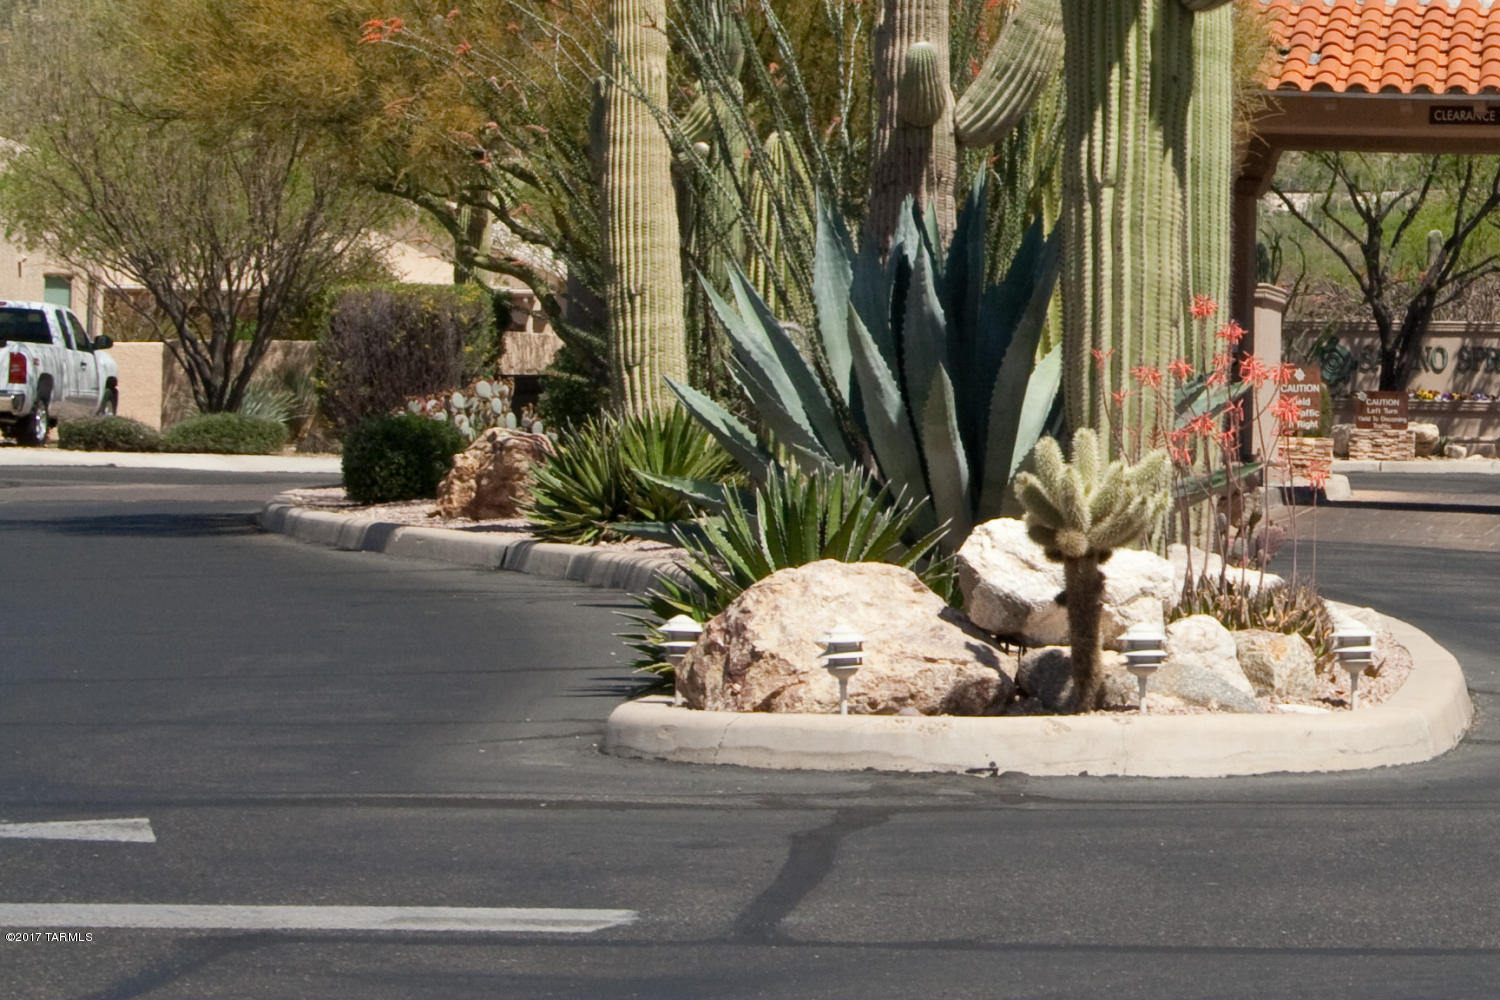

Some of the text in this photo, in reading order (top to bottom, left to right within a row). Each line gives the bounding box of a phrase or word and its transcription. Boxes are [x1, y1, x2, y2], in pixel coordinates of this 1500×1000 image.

[1434, 110, 1496, 121] CLEARANCE
[1281, 384, 1320, 392] CAUTION
[1291, 397, 1311, 406] ield
[1297, 420, 1319, 430] Right
